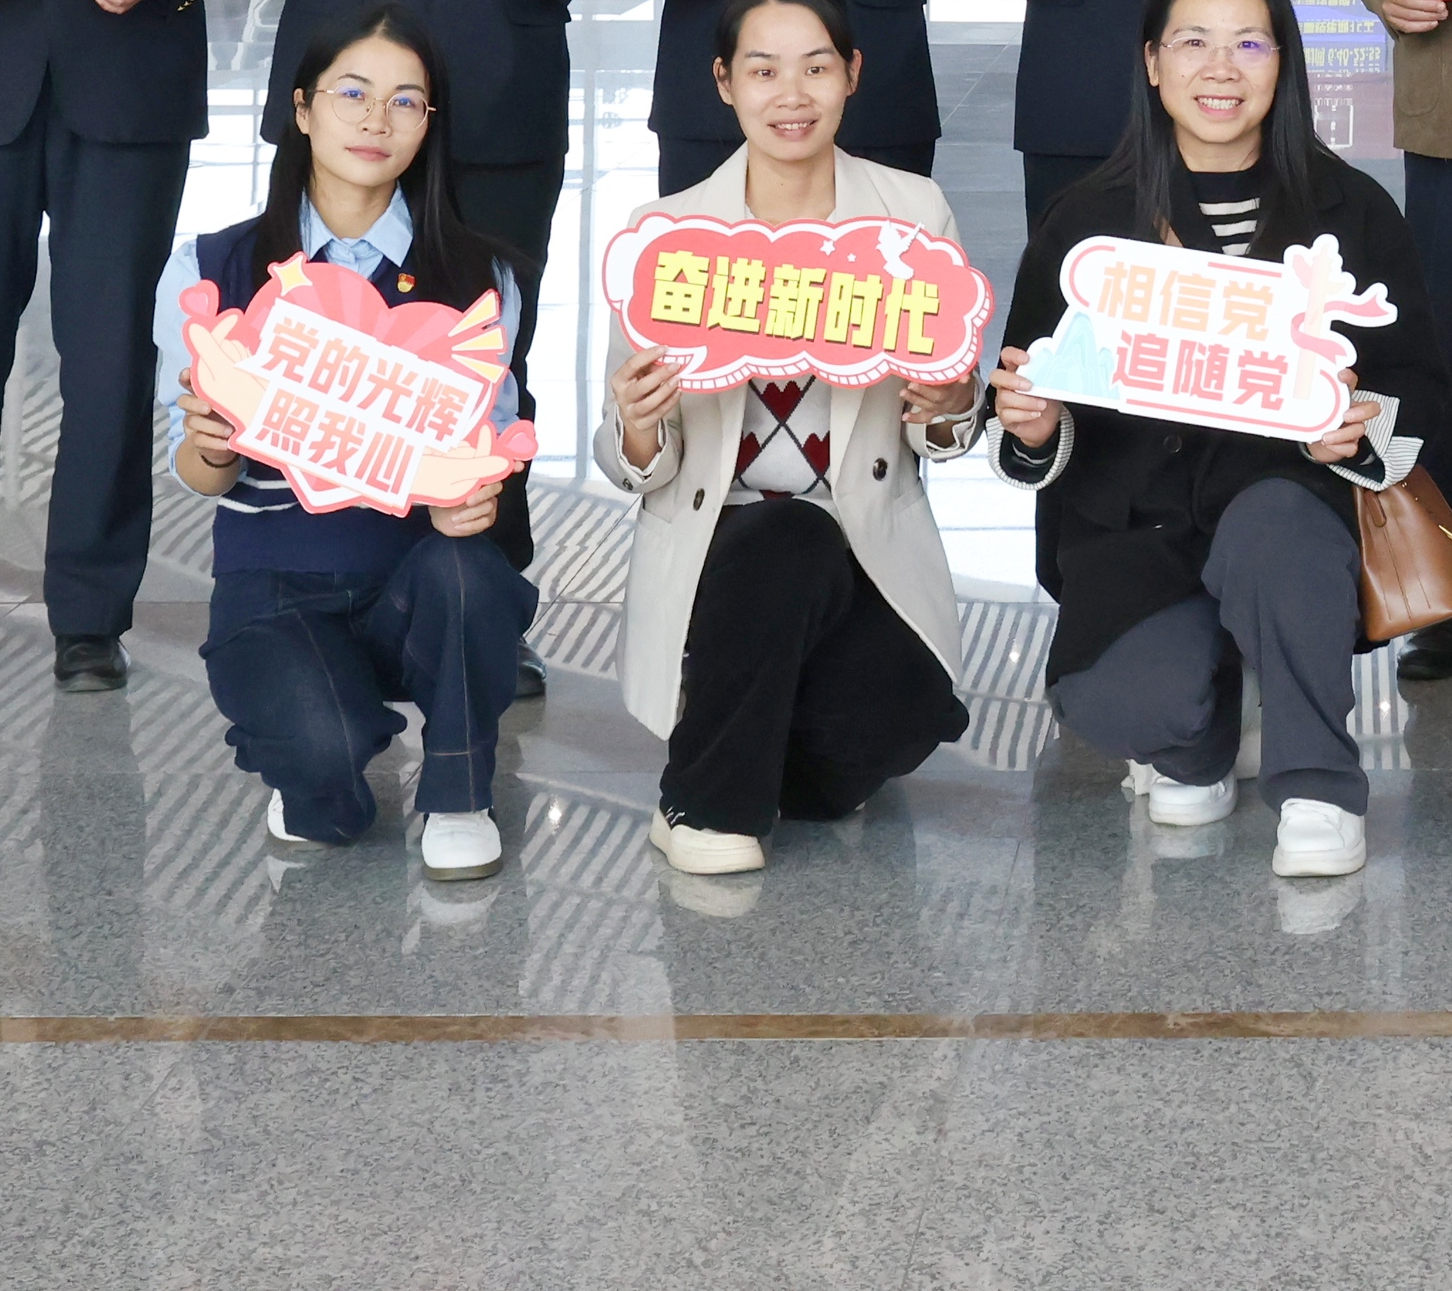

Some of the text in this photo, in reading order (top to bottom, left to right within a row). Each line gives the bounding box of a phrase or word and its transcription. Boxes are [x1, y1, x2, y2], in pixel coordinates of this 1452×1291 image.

[650, 249, 940, 355] 奋进新时代
[1097, 260, 1274, 342] 相信党
[262, 317, 470, 442] 党的光辉
[1112, 330, 1289, 410] 追随党
[255, 388, 415, 496] 照我心
